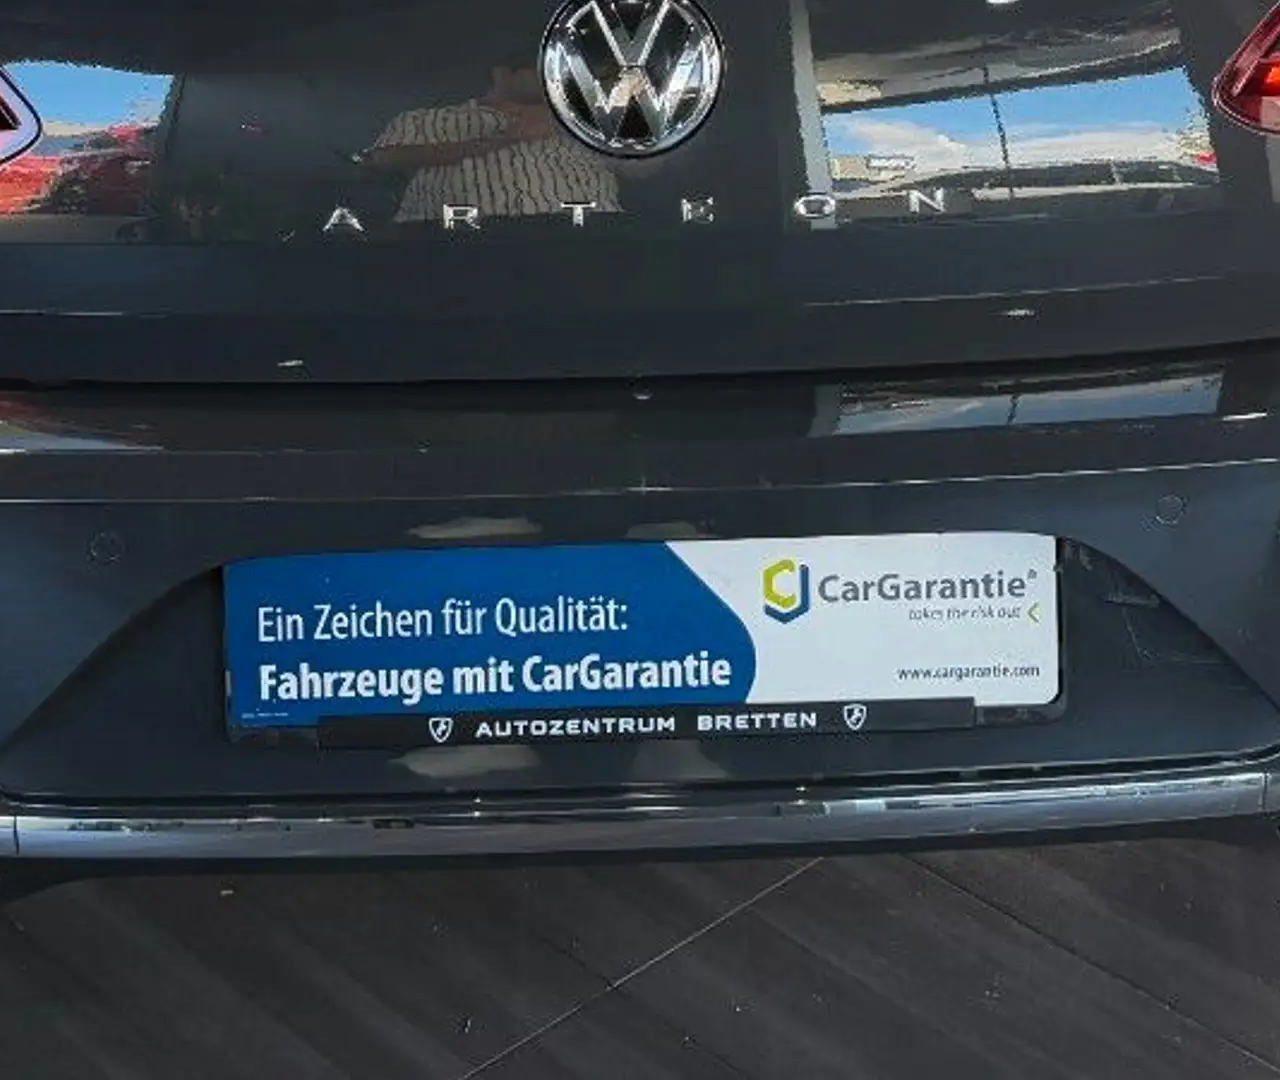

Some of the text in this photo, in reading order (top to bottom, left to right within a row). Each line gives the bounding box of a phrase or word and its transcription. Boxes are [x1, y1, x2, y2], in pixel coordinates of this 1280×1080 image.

[322, 188, 947, 232] ARTEON
[258, 595, 628, 642] Ein Zeichen für Qualität:
[259, 650, 731, 706] Fahrzeuge mit CarGarantie
[898, 663, 1040, 682] www.cargarantie.com
[475, 712, 817, 739] AUTOZENTRUM BRETTEN
